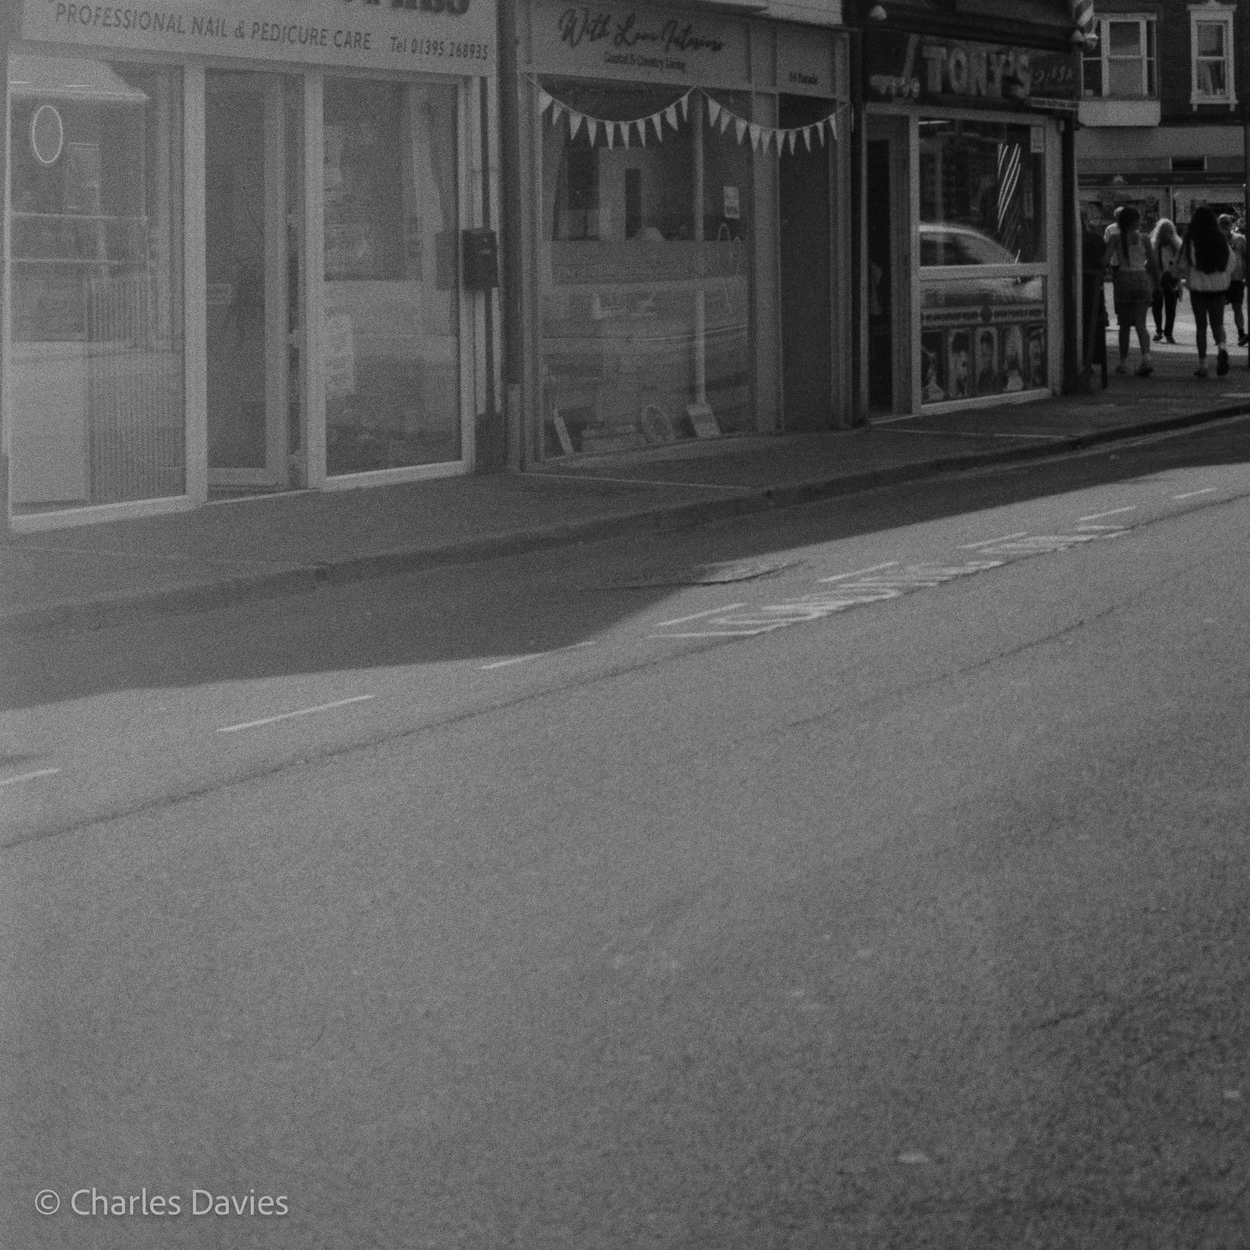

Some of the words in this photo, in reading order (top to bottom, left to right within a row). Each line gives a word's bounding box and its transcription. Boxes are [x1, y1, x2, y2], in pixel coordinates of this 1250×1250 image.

[55, 2, 186, 35] PROFESSIONAL
[190, 16, 228, 38] NAIL
[233, 19, 246, 39] &
[251, 20, 329, 47] PEDICURE
[332, 29, 372, 51] CARE
[921, 45, 1030, 99] TONY'S
